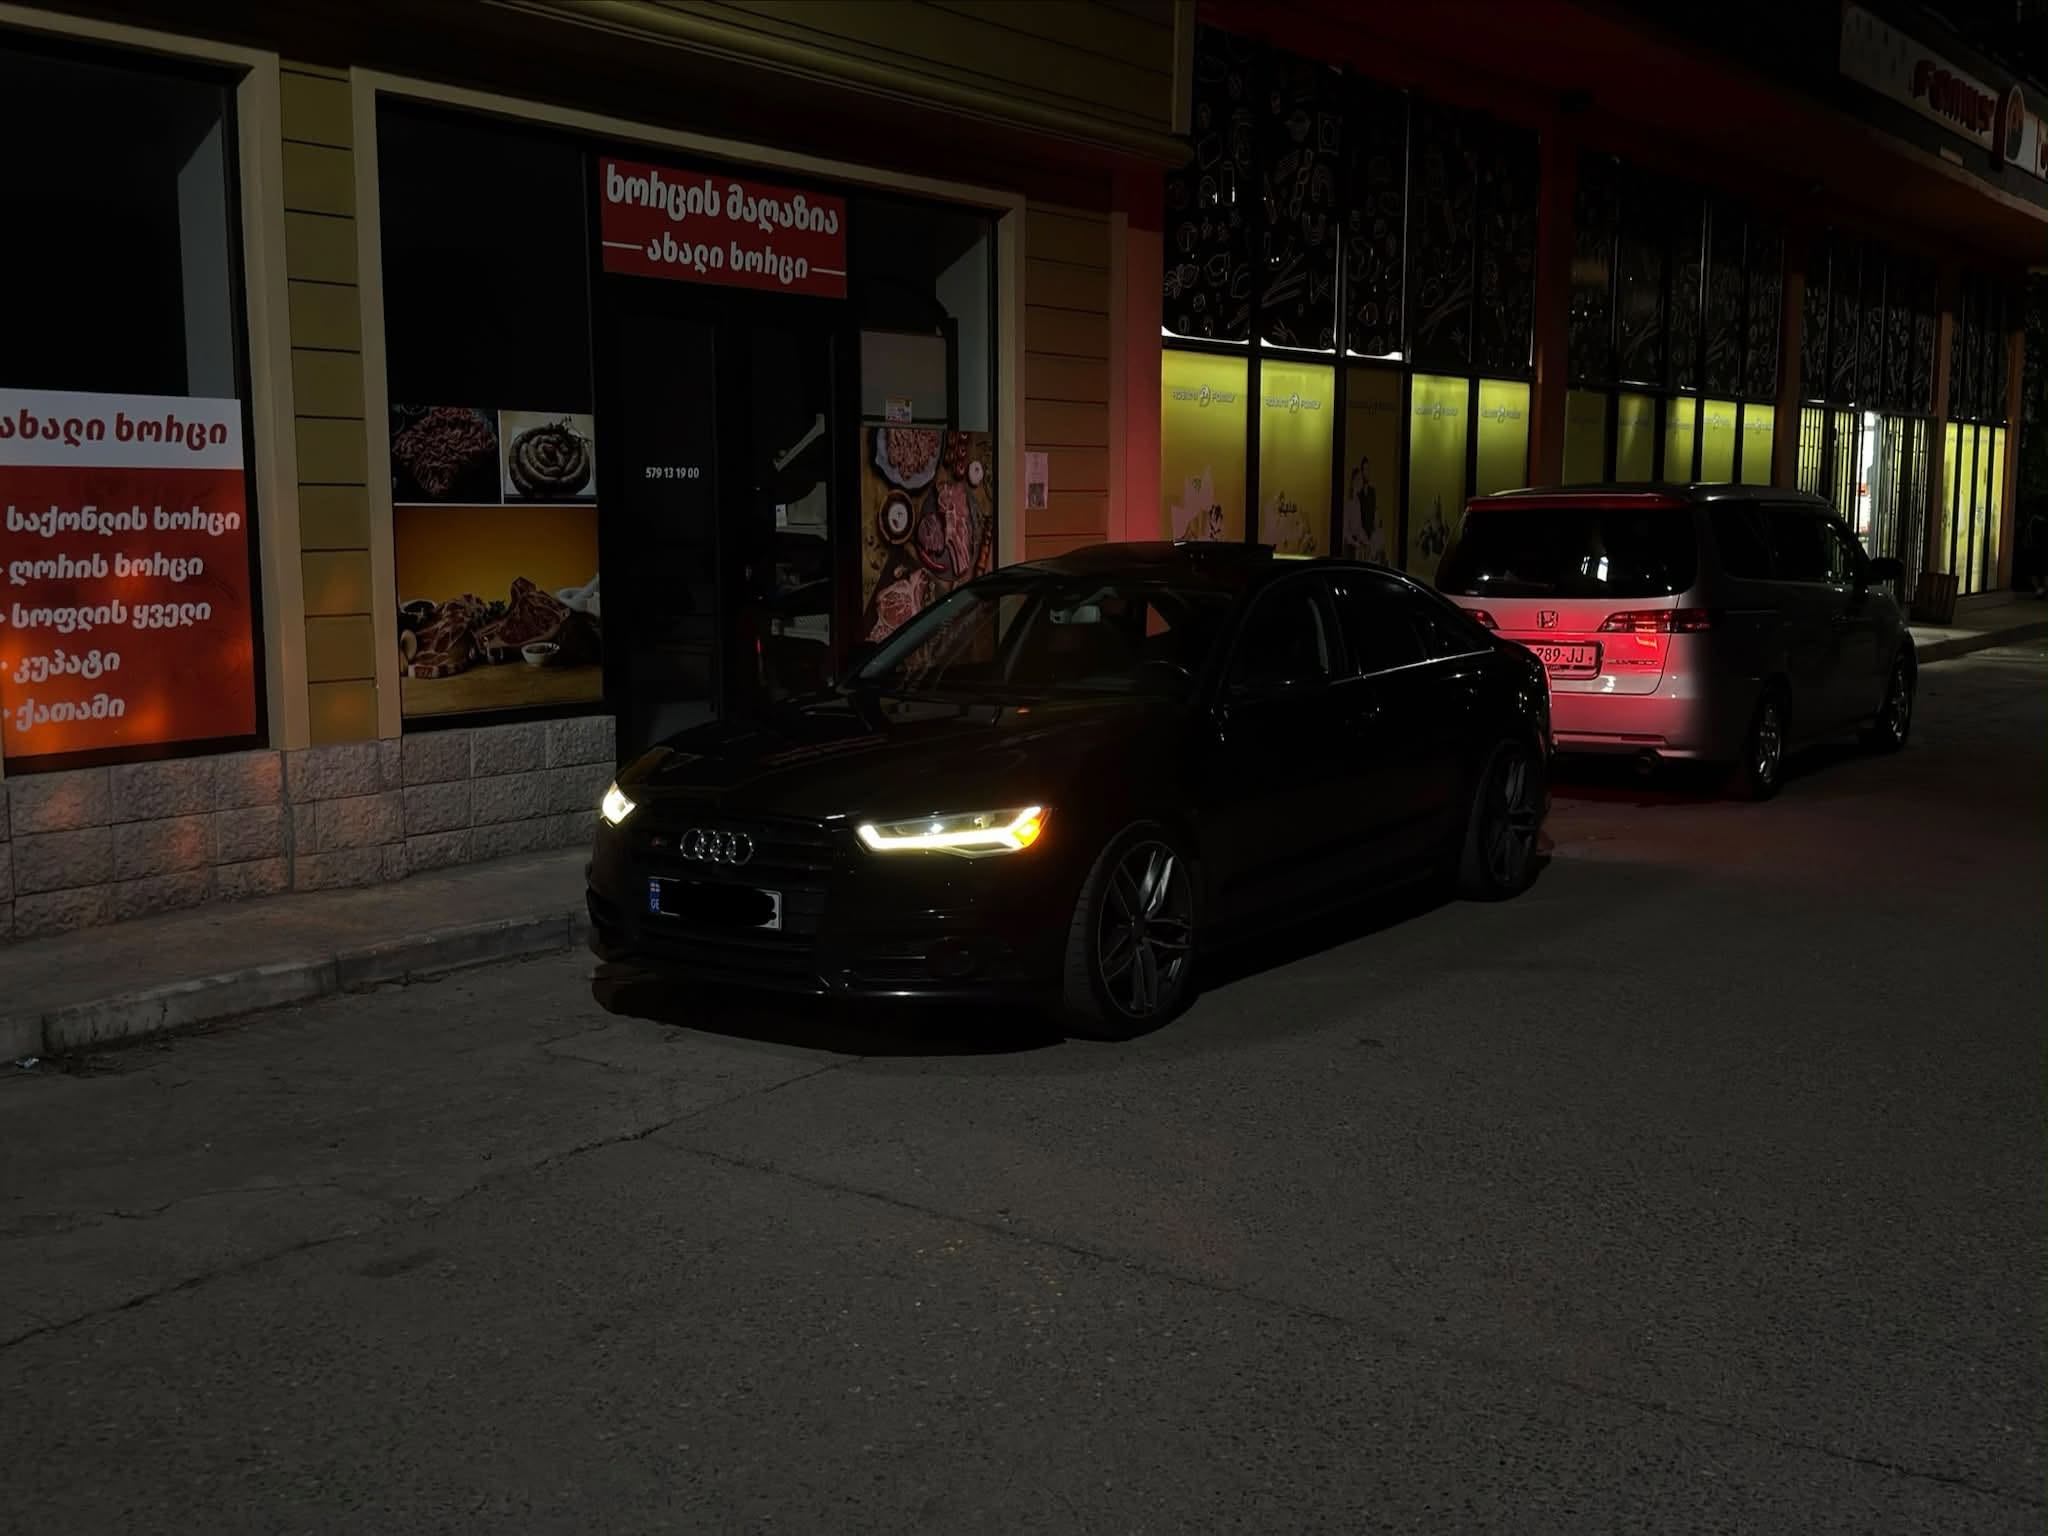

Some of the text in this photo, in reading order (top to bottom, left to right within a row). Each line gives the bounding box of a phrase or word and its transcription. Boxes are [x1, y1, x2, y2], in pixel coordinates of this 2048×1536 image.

[606, 163, 839, 235] ხორცის მაღაზია
[647, 232, 809, 286] ახალი ხორცი
[0, 409, 228, 451] ახალი ხორცი
[645, 466, 662, 479] 579
[664, 466, 674, 479] 13
[687, 466, 700, 479] 00
[6, 505, 241, 538] საქონლის ხორცი
[8, 551, 204, 586] ღორის ხორცი
[11, 599, 212, 634] სოფლის ყველი
[13, 648, 121, 684] კუპატი
[15, 693, 126, 732] ქათამი
